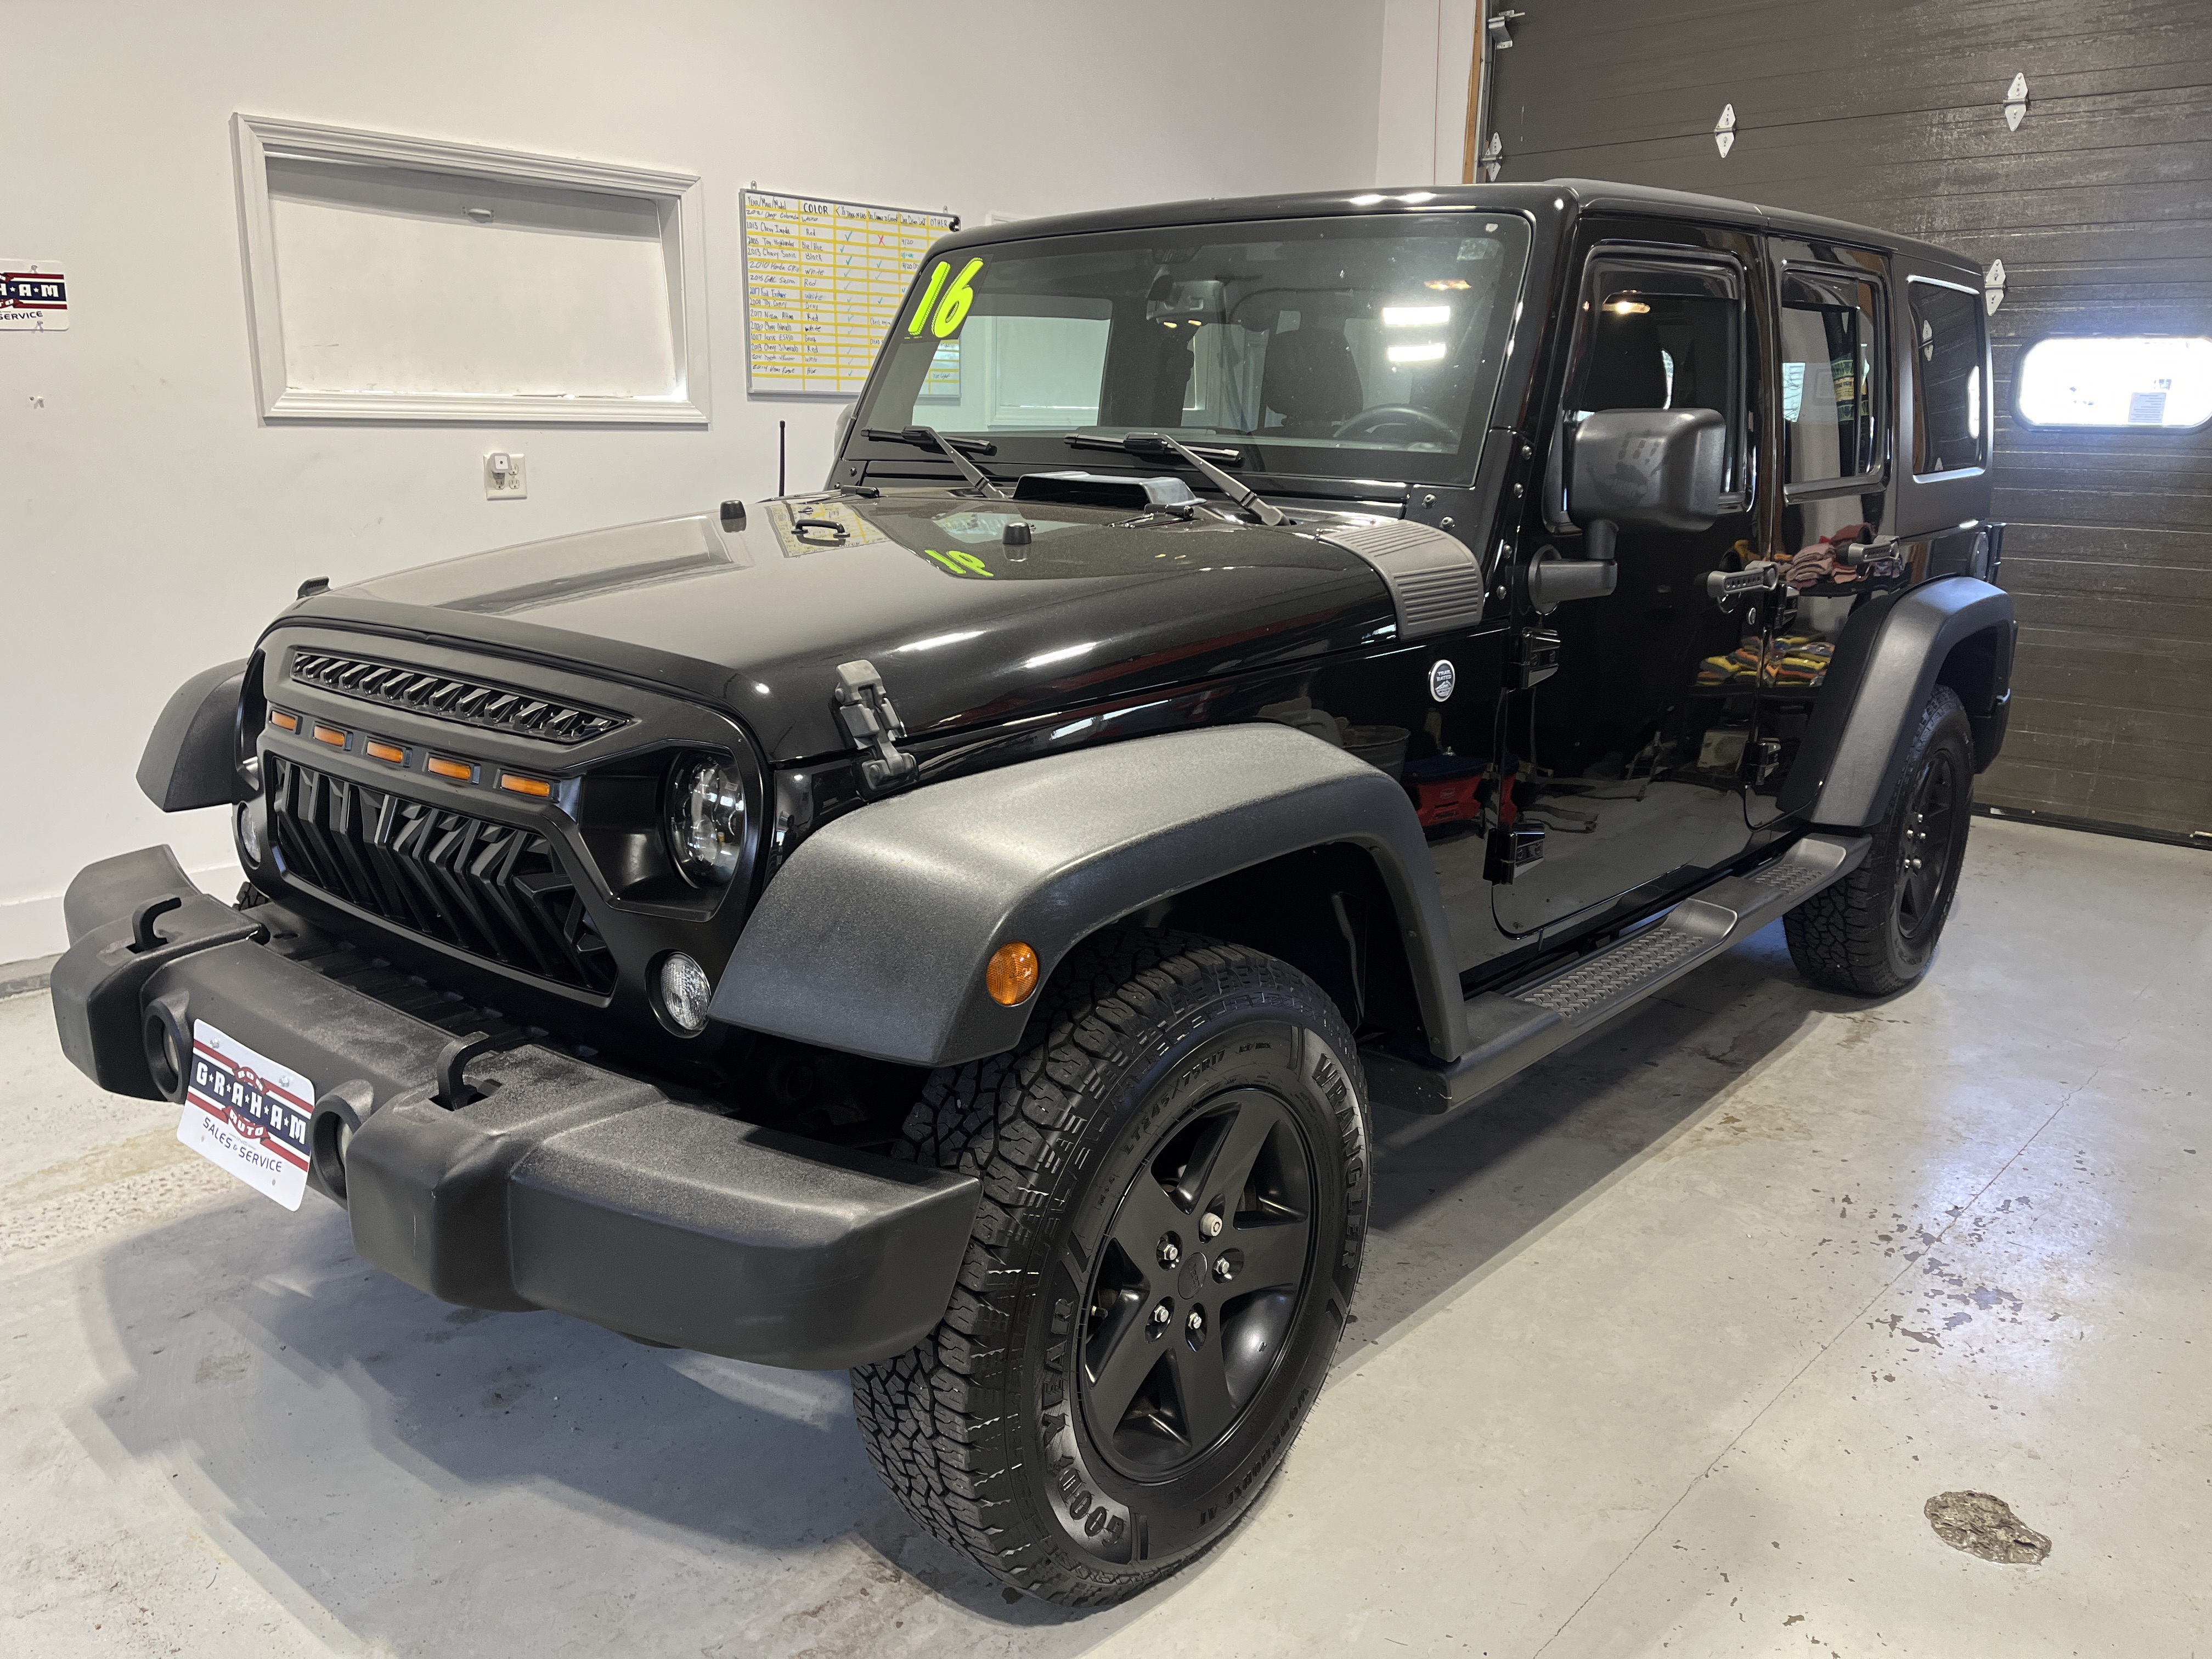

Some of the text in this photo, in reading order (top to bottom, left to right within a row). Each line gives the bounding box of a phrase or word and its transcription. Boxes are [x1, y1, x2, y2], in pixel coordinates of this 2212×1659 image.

[803, 202, 829, 215] COLOR
[930, 218, 948, 228] OTHER
[747, 247, 761, 256] 2013
[805, 252, 823, 262] Black
[749, 261, 770, 269] 2010
[770, 262, 785, 270] Honda
[804, 278, 816, 287] Red
[908, 256, 984, 338] 16
[750, 309, 762, 318] 2017
[806, 313, 819, 322] Red
[806, 345, 819, 353] Red
[229, 1108, 264, 1137] AUTO
[202, 1117, 233, 1149] SALES
[238, 1147, 283, 1173] SERVICE
[1312, 1052, 1365, 1269] WRANGLER
[1042, 1297, 1124, 1547] GOODYEAR
